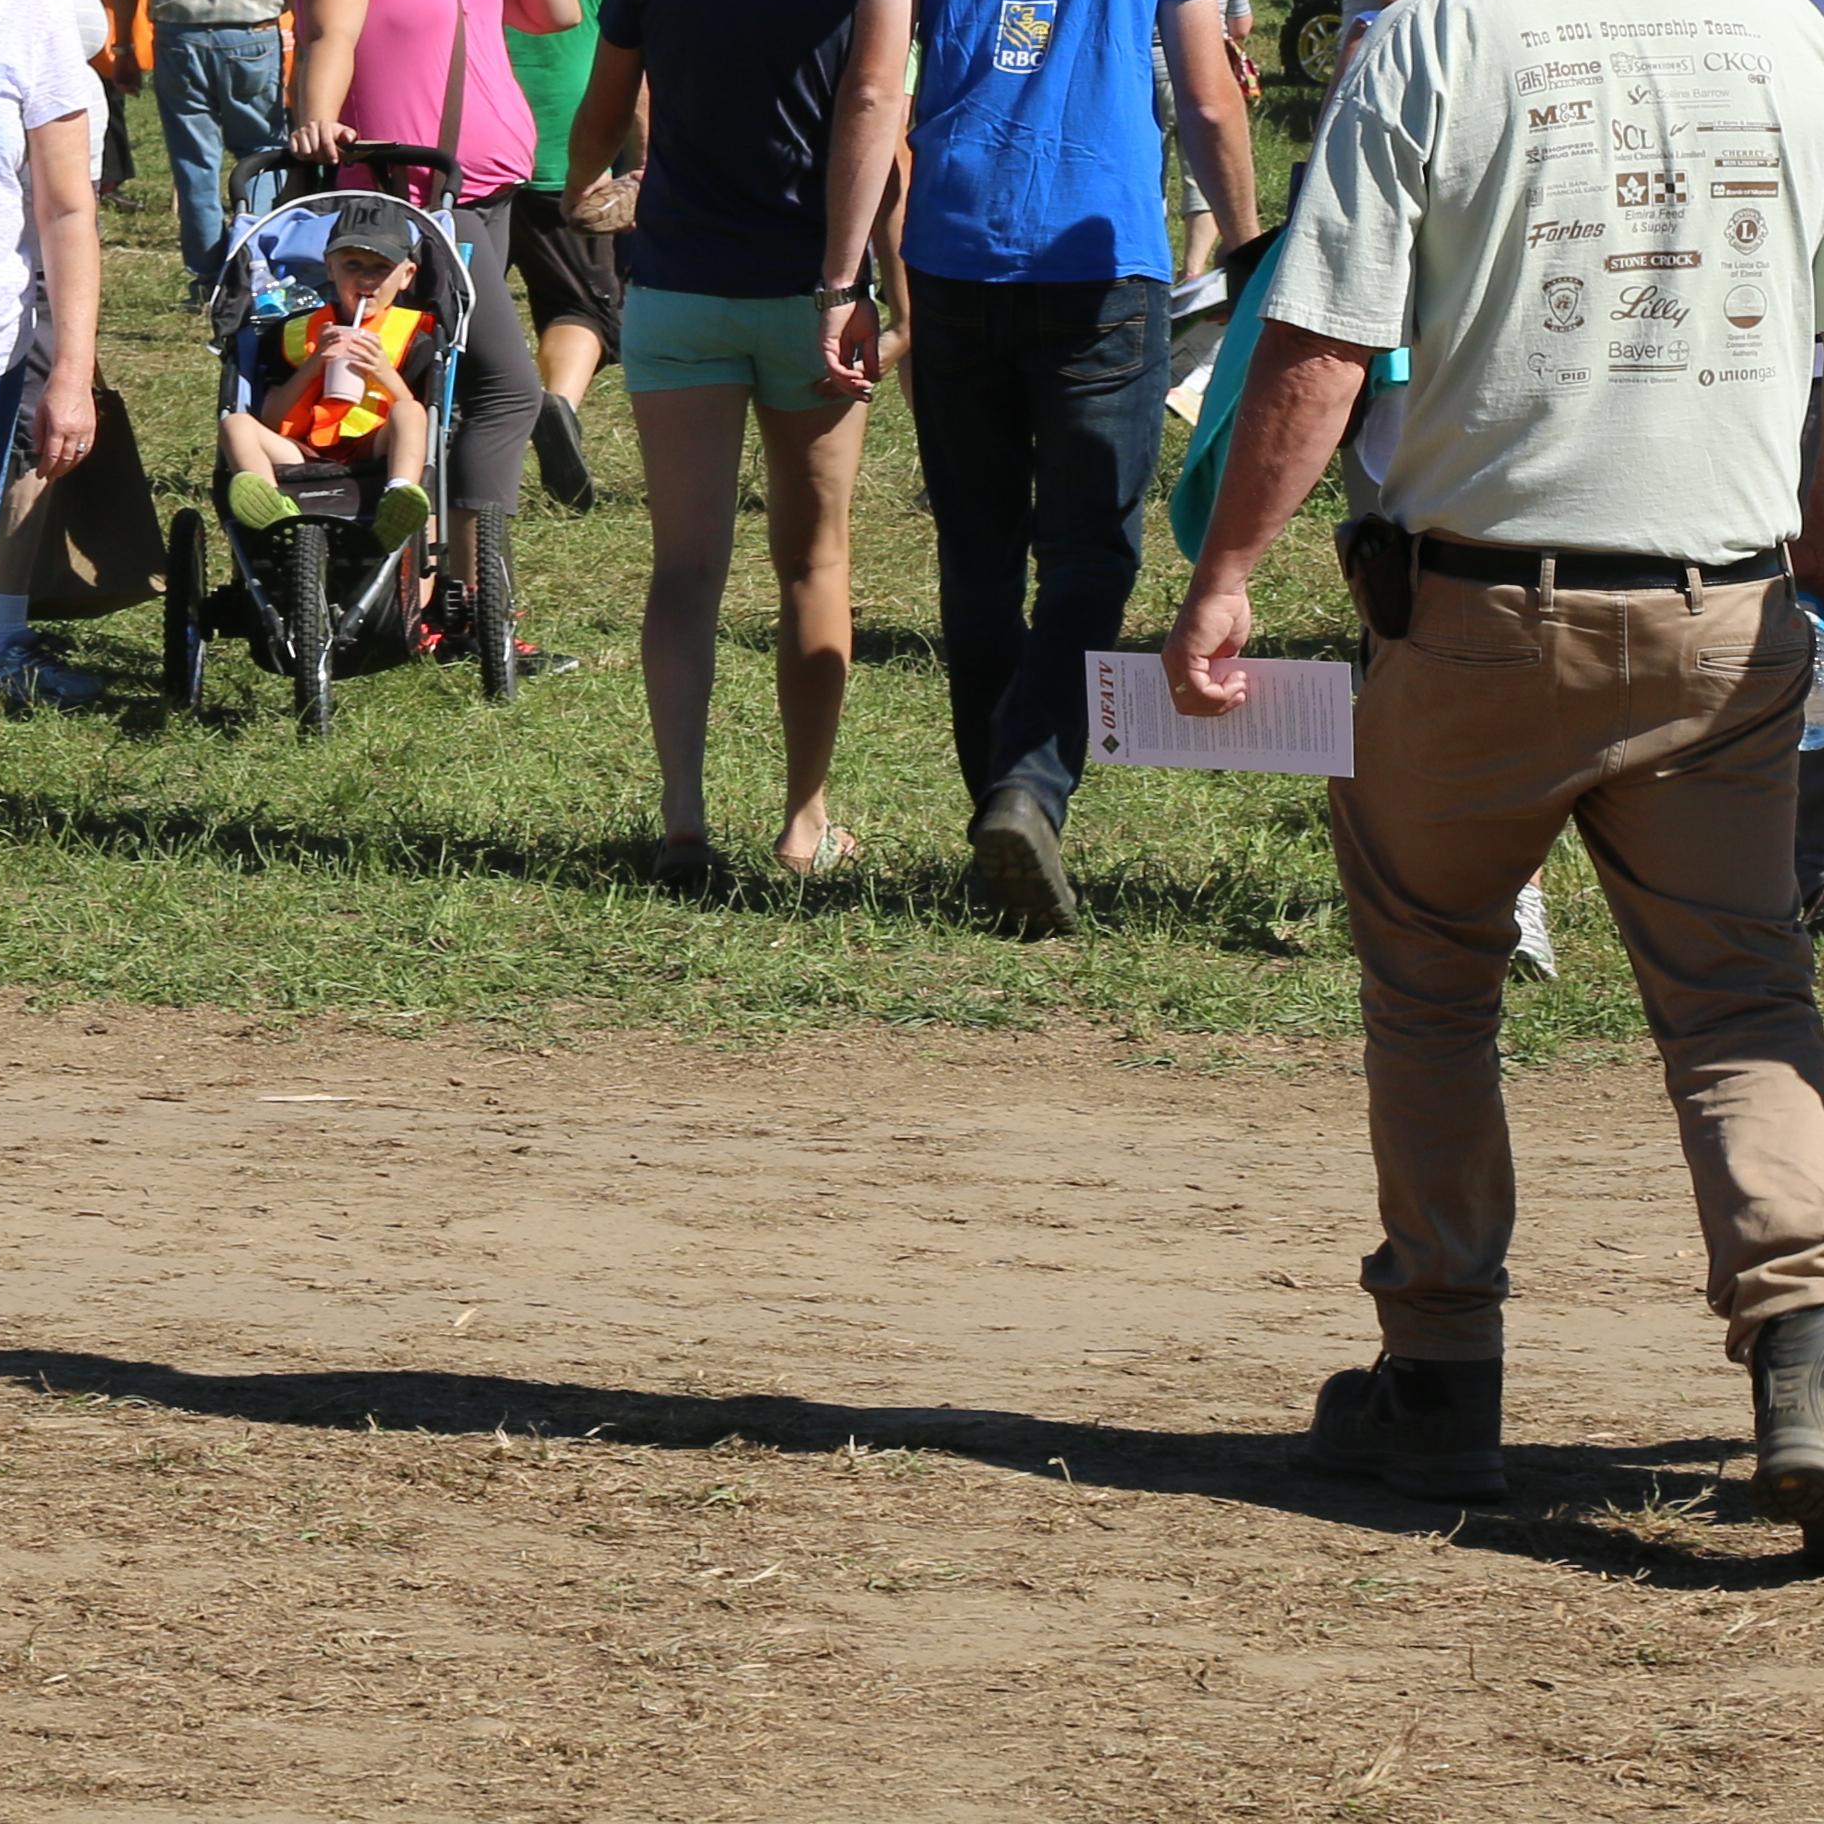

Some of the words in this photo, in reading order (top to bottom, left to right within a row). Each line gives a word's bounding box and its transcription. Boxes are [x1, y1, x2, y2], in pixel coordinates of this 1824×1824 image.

[1521, 30, 1551, 48] The
[1556, 22, 1592, 42] 2001
[1600, 19, 1698, 40] Sponsorship
[1000, 50, 1044, 67] RBC
[1704, 52, 1772, 73] CKCO
[1544, 61, 1602, 78] Home
[1549, 75, 1604, 90] hardware
[1693, 88, 1730, 98] Barrow
[1528, 100, 1593, 128] M&T
[1612, 119, 1655, 151] SCL
[1541, 142, 1594, 154] SHOPPERS
[1541, 151, 1569, 161] DRUG
[1675, 149, 1706, 159] Limited
[1625, 208, 1656, 221] Elmira
[1657, 208, 1685, 220] Feed
[1527, 219, 1606, 249] Forbes
[1640, 221, 1677, 235] Supply
[1610, 255, 1647, 270] STONE
[1650, 253, 1695, 268] CROCK
[1610, 285, 1691, 329] Lilly
[1609, 340, 1664, 361] Bayer
[1099, 660, 1116, 730] OFATV
